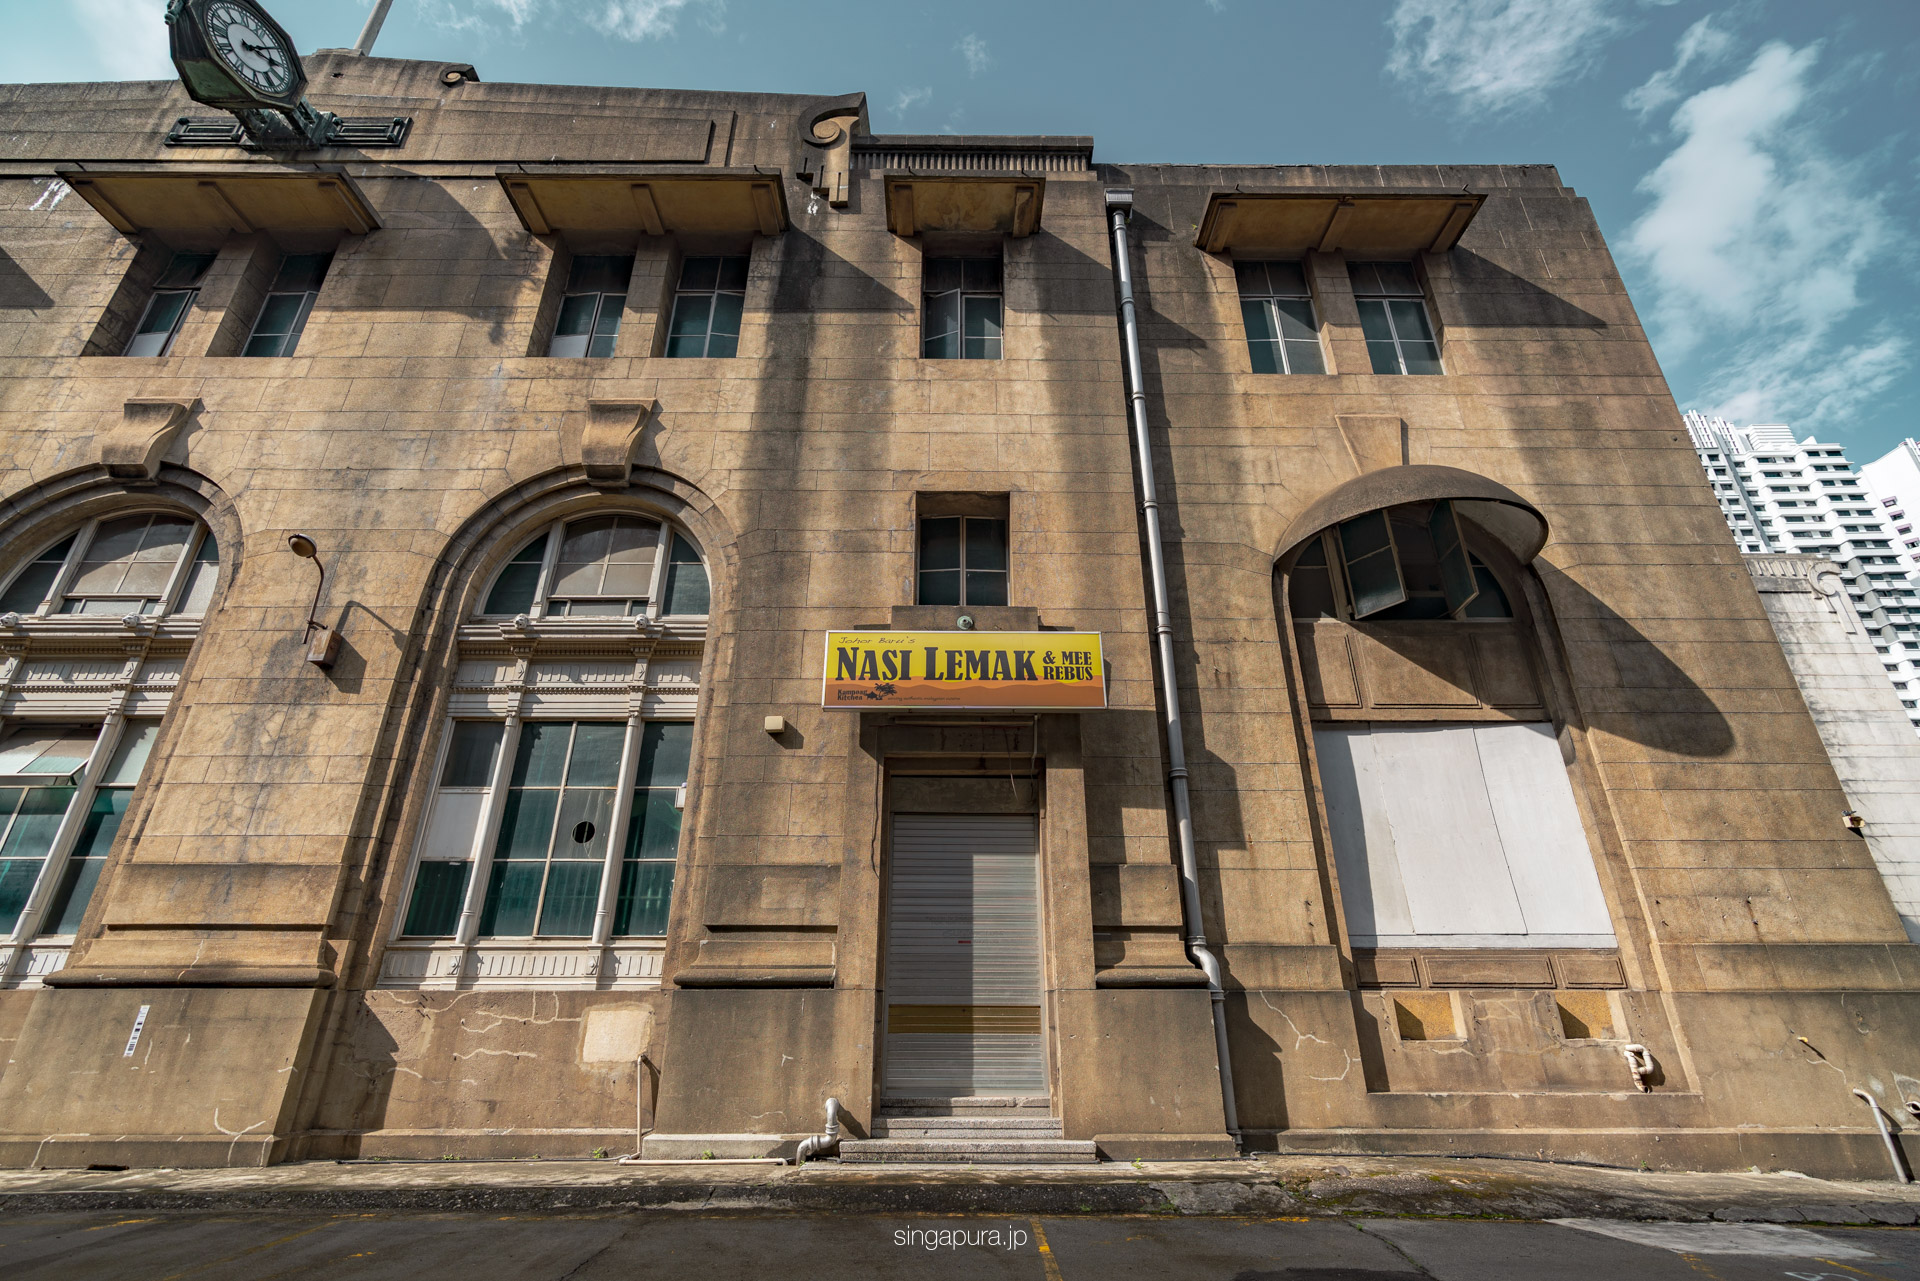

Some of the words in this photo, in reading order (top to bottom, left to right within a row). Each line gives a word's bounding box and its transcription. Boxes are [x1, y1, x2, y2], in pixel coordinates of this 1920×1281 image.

[838, 636, 873, 644] Johor
[878, 635, 916, 644] Baru's
[835, 646, 912, 681] NASI
[923, 646, 1038, 681] LEMAK
[1042, 650, 1056, 665] &
[1062, 651, 1093, 666] MEE
[1042, 665, 1094, 681] REBUS
